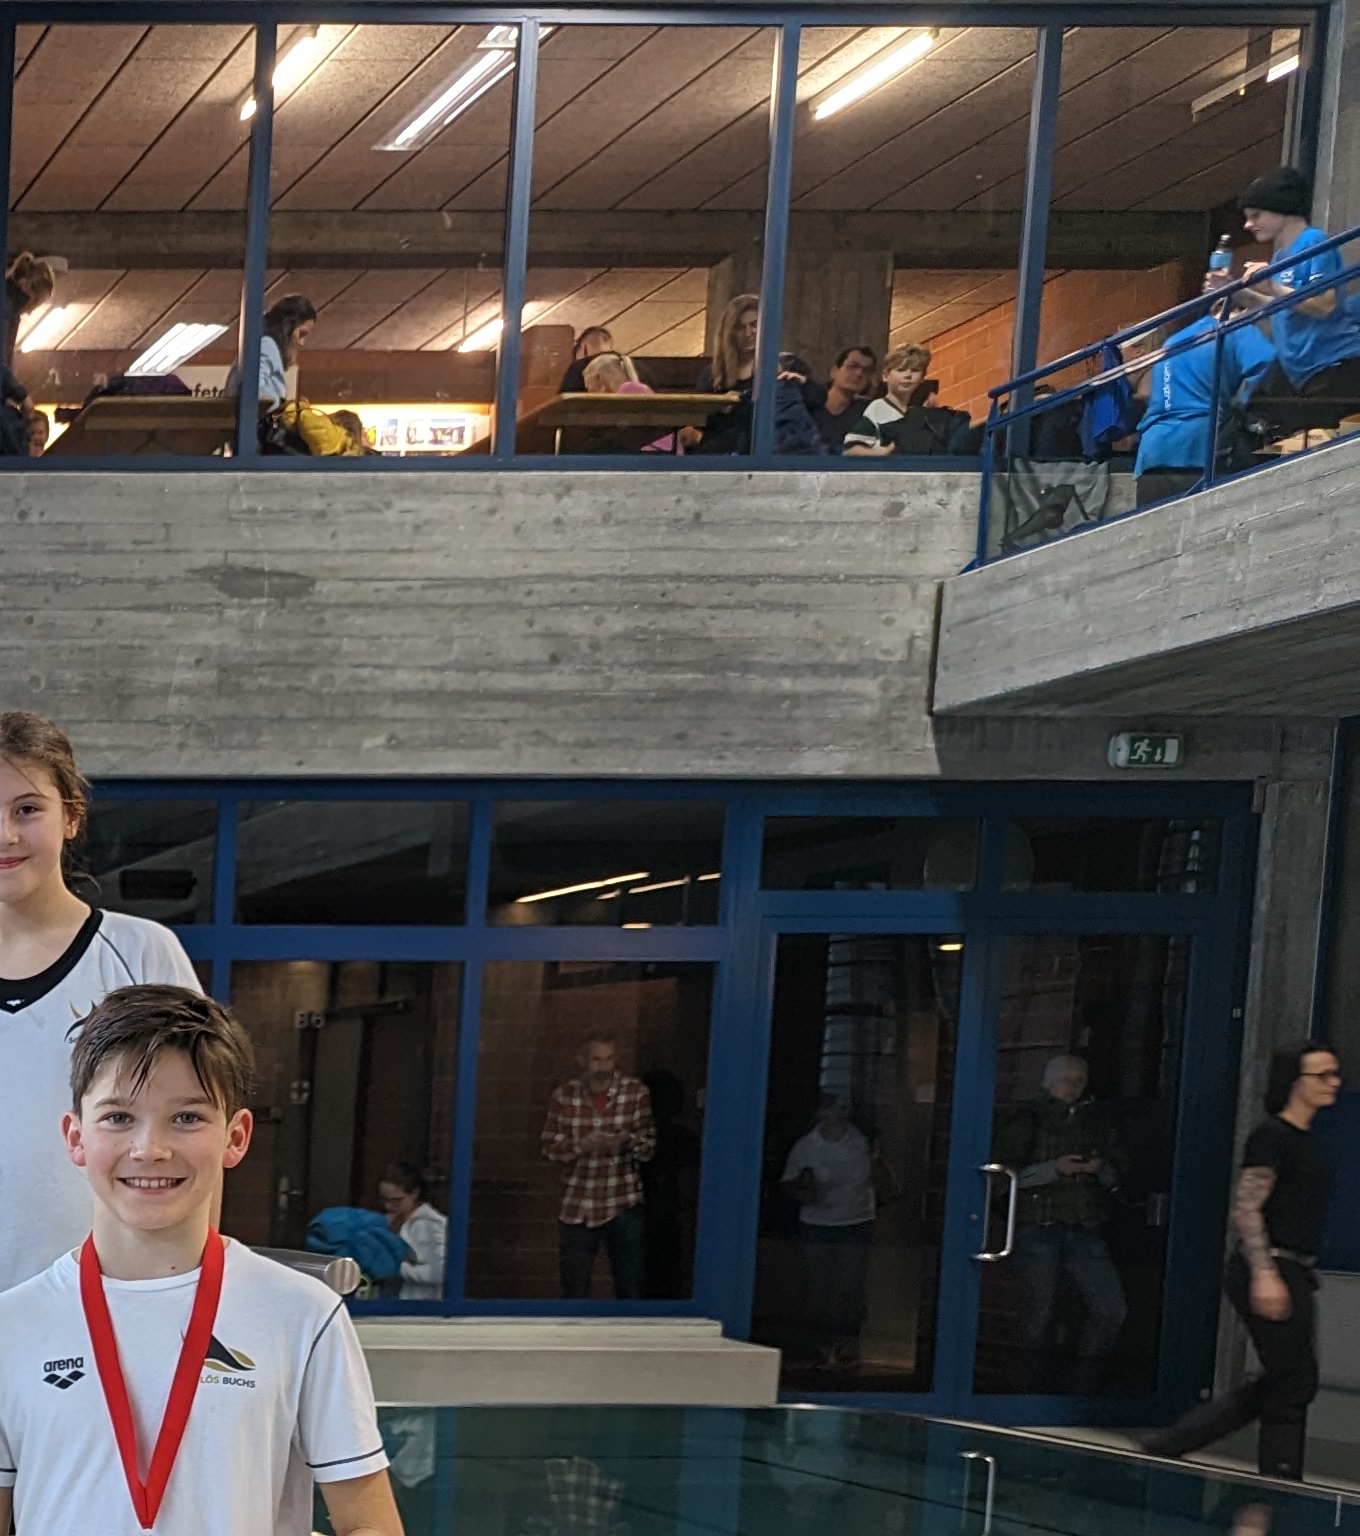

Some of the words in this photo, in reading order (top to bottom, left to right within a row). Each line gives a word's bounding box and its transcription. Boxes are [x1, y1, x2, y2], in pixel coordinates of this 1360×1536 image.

[43, 1356, 84, 1373] arena
[200, 1375, 220, 1384] LÖS
[222, 1376, 256, 1388] BUCHS
